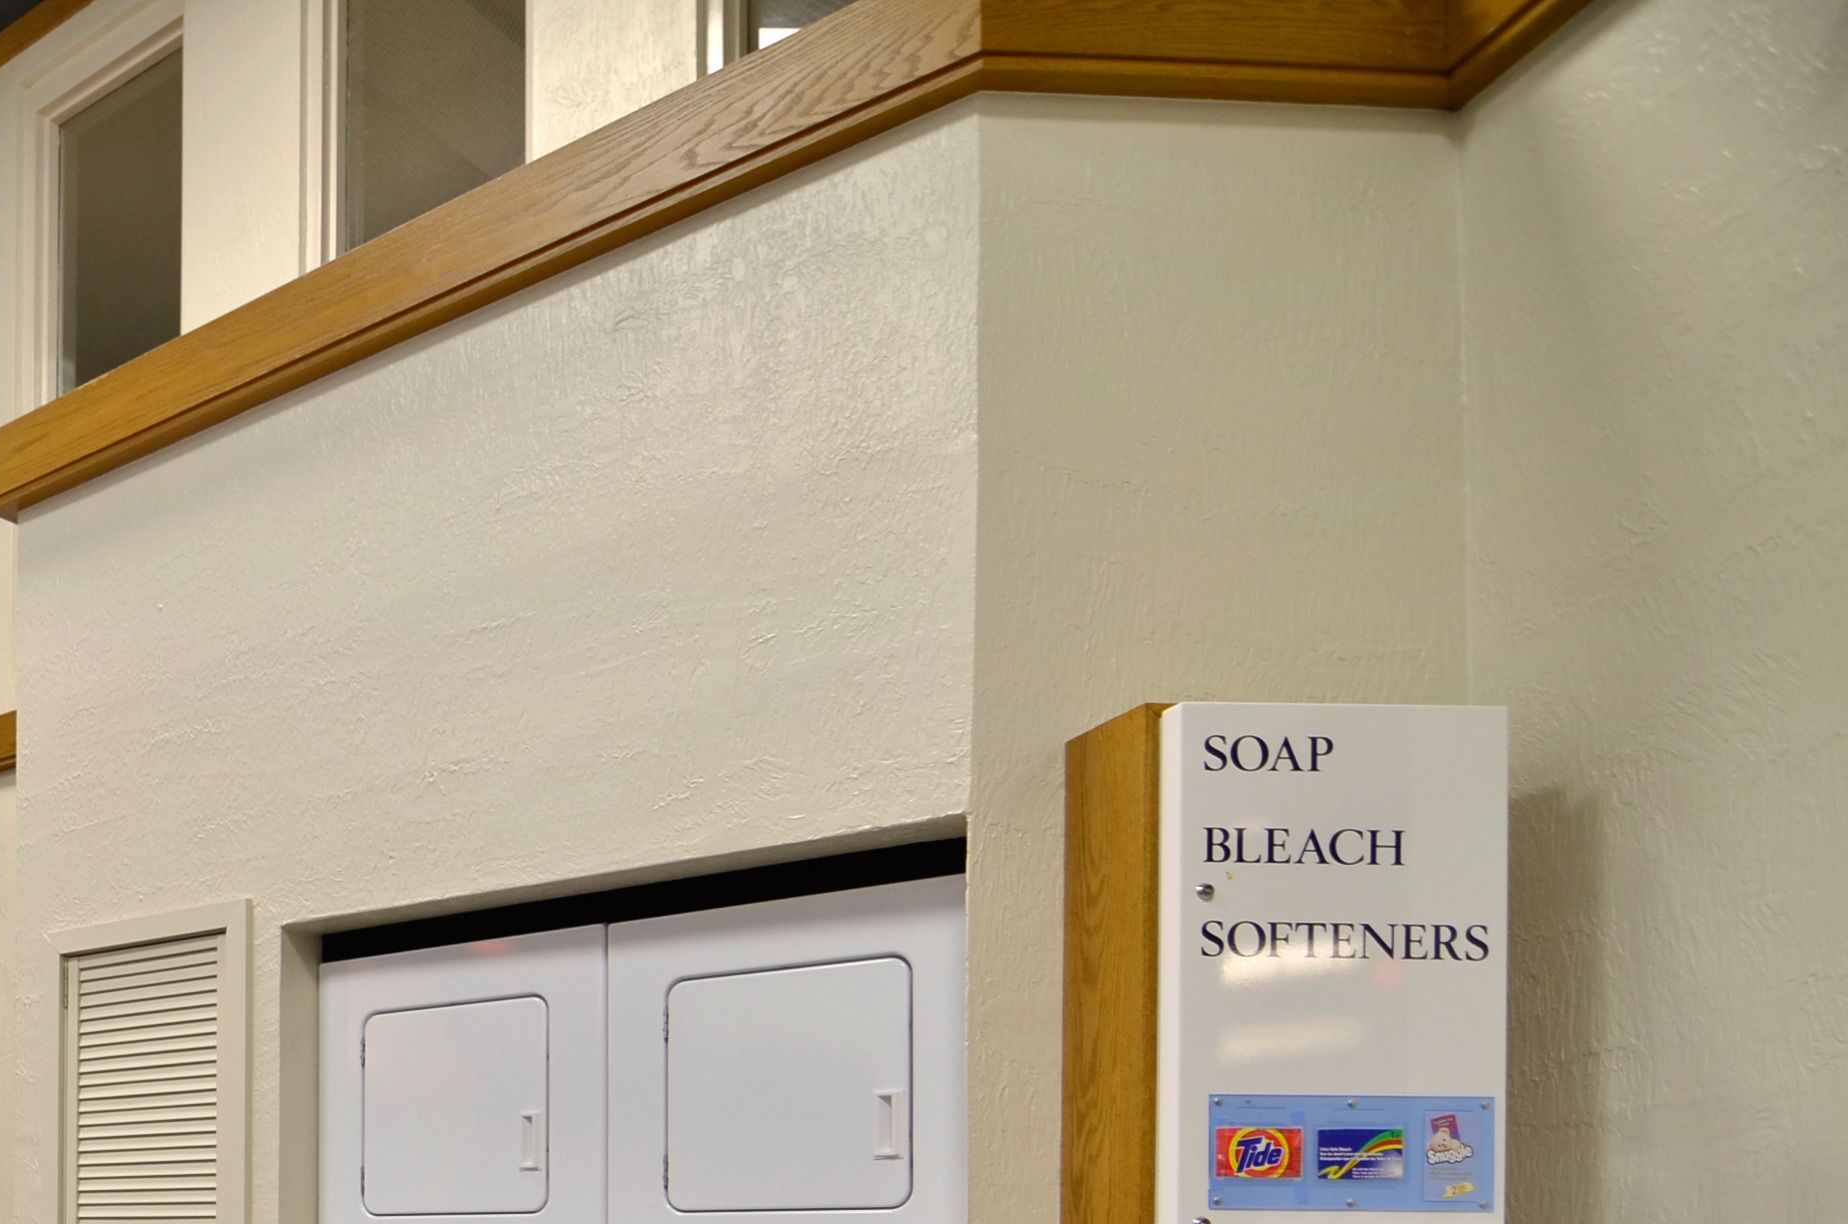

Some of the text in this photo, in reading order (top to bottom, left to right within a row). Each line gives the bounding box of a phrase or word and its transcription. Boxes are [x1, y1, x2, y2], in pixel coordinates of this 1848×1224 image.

[1203, 734, 1334, 772] SOAP
[1202, 827, 1406, 866] BLEACH
[1200, 920, 1490, 962] SOFTENERS
[1236, 1135, 1283, 1174] Tide
[1427, 1143, 1474, 1166] Snuggle
